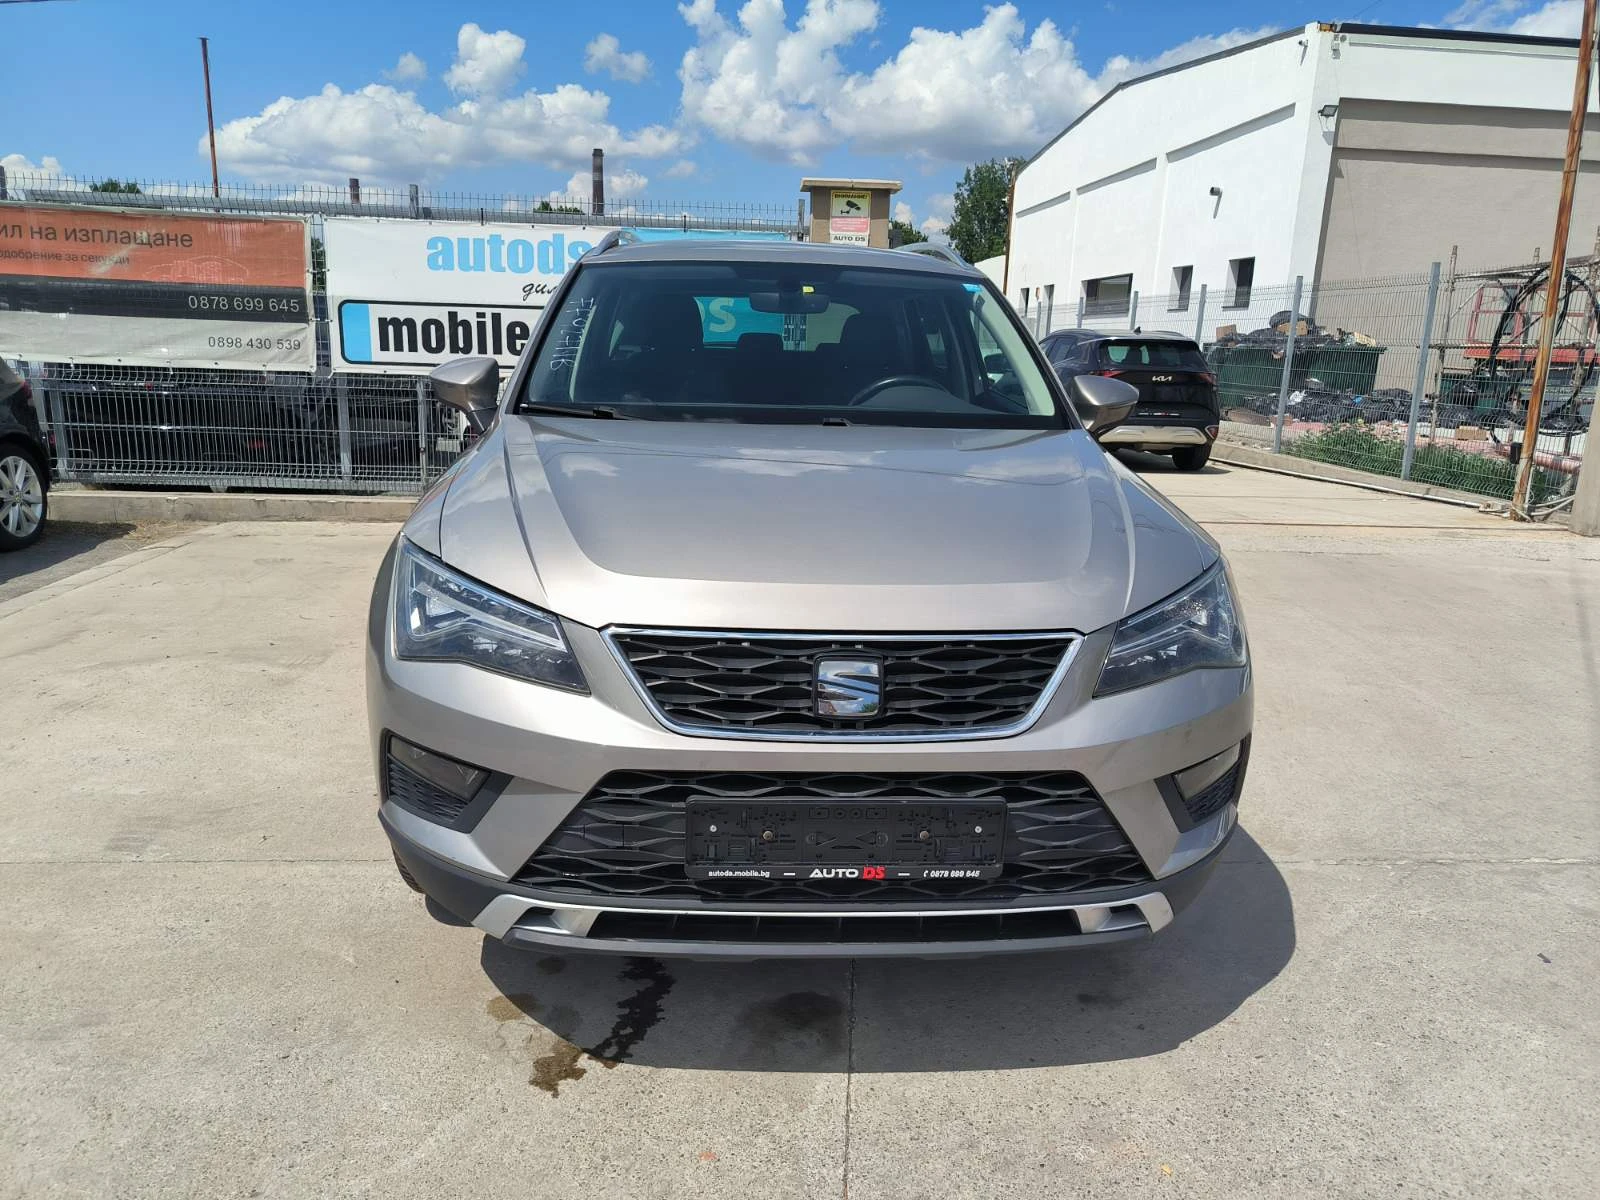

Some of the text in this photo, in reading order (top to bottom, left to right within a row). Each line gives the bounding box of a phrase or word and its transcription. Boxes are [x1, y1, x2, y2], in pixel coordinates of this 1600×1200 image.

[30, 226, 57, 240] на
[64, 227, 193, 248] изплащане
[64, 253, 78, 262] за
[80, 254, 130, 265] секуди
[188, 295, 300, 312] 0878 699 645
[378, 311, 530, 356] mobile
[208, 336, 301, 350] 0898 430 539
[809, 868, 859, 878] AUTO
[862, 866, 886, 879] DS
[930, 870, 949, 878] 0878
[965, 870, 981, 878] 645
